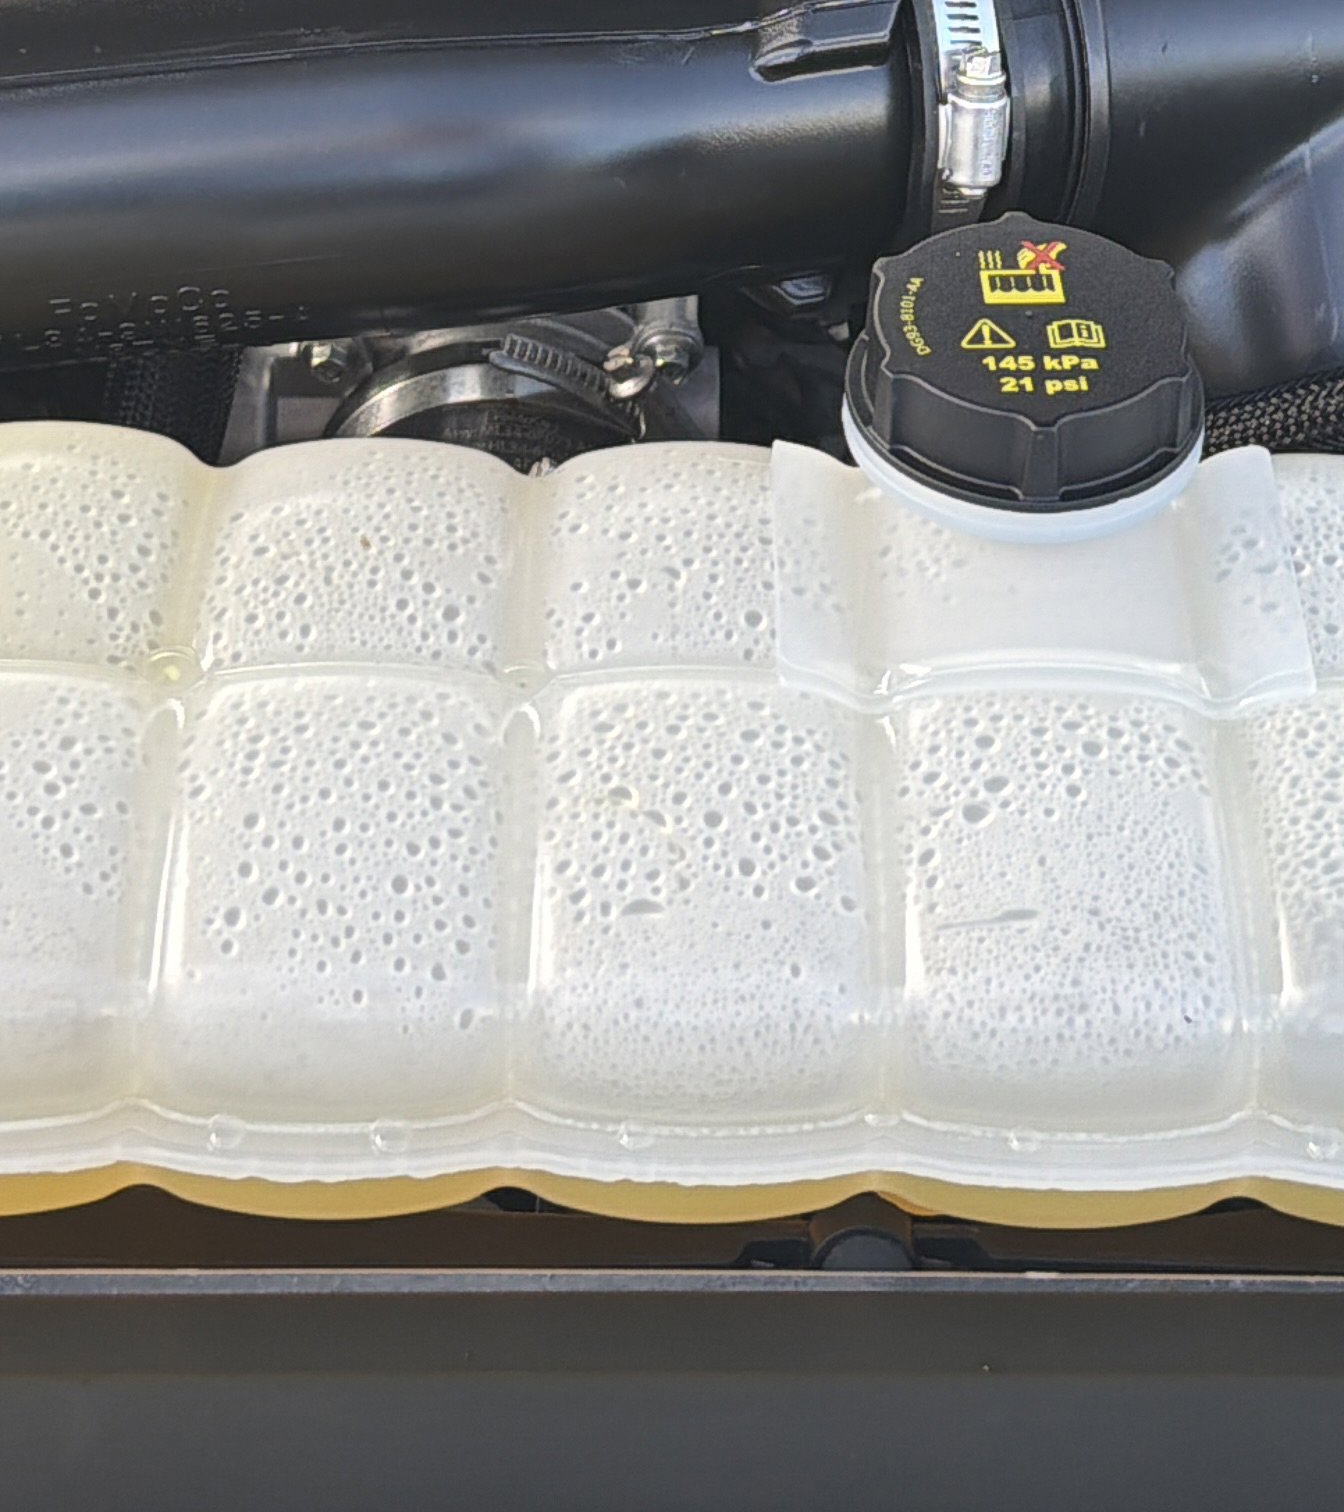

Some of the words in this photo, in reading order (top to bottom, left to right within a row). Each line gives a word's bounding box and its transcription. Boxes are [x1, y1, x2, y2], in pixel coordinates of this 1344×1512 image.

[981, 355, 1035, 372] 145
[1042, 355, 1099, 372] kPa
[999, 377, 1035, 393] 21
[1045, 376, 1090, 396] psi
